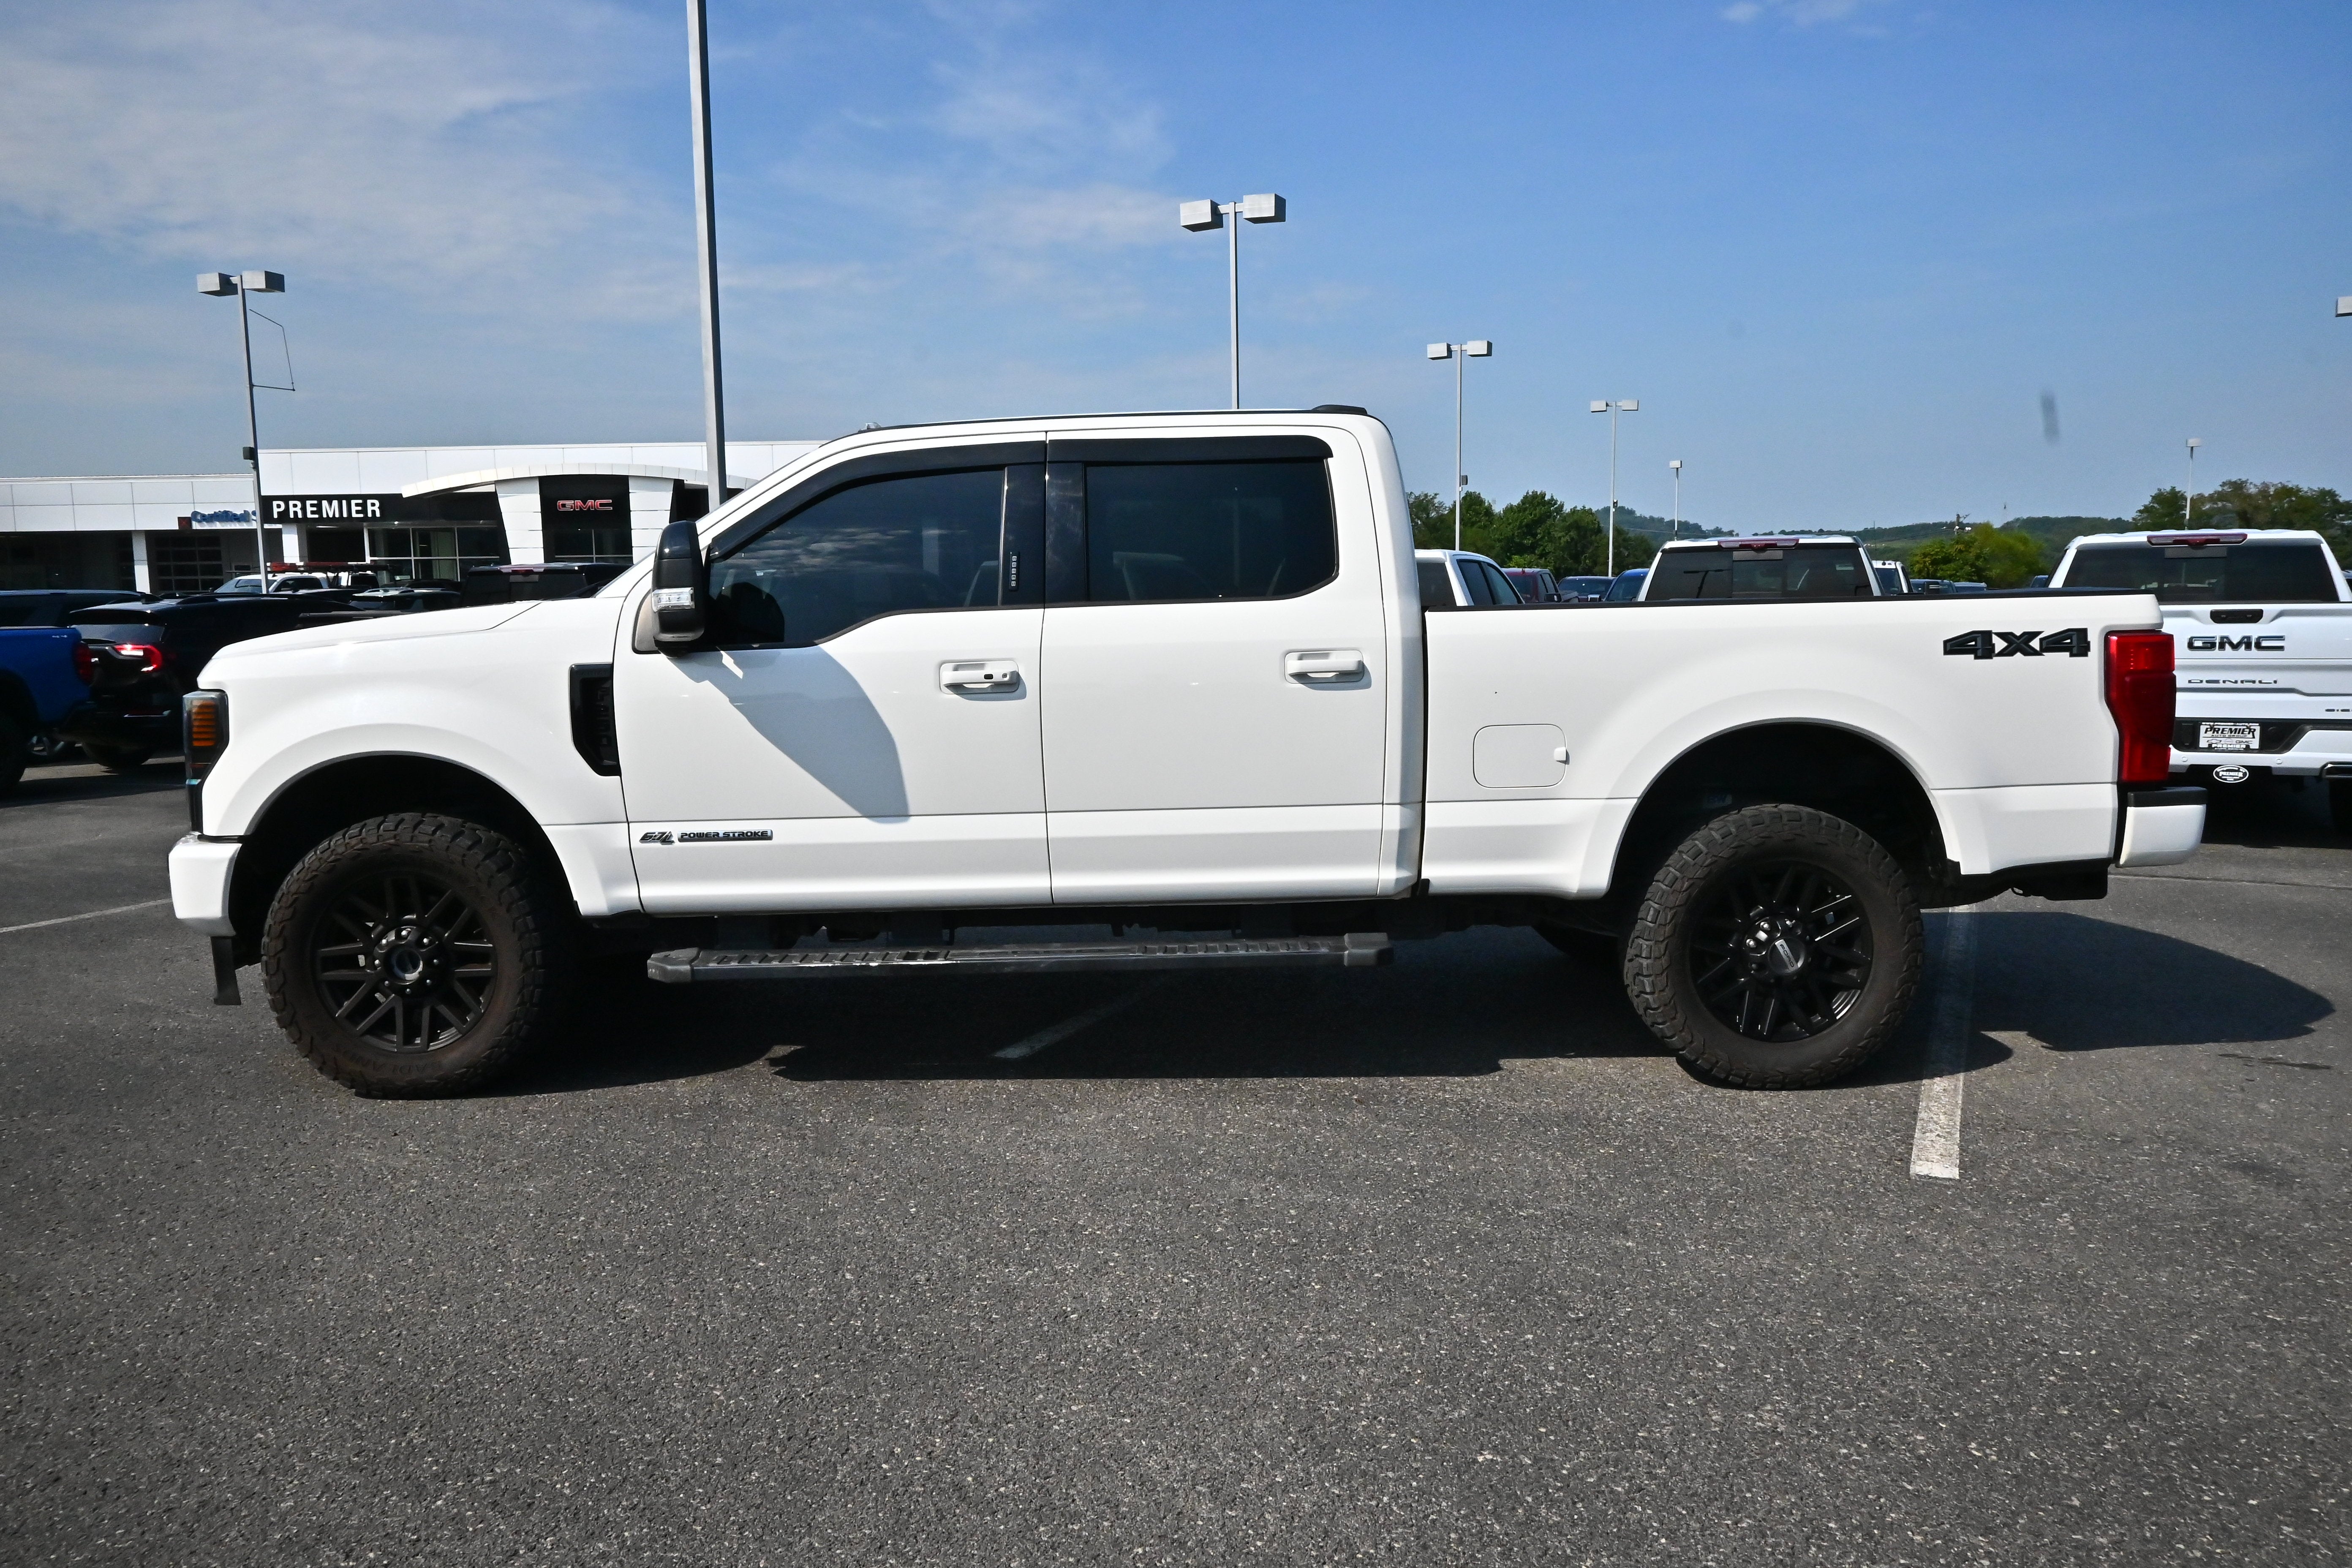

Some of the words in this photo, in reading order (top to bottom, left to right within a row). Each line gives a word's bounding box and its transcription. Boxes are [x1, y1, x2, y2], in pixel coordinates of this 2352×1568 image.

[272, 499, 380, 518] PREMIER
[557, 499, 612, 511] GMC
[2187, 635, 2285, 651] GMC
[2204, 727, 2256, 738] PREMIER
[1780, 944, 1794, 967] FORD
